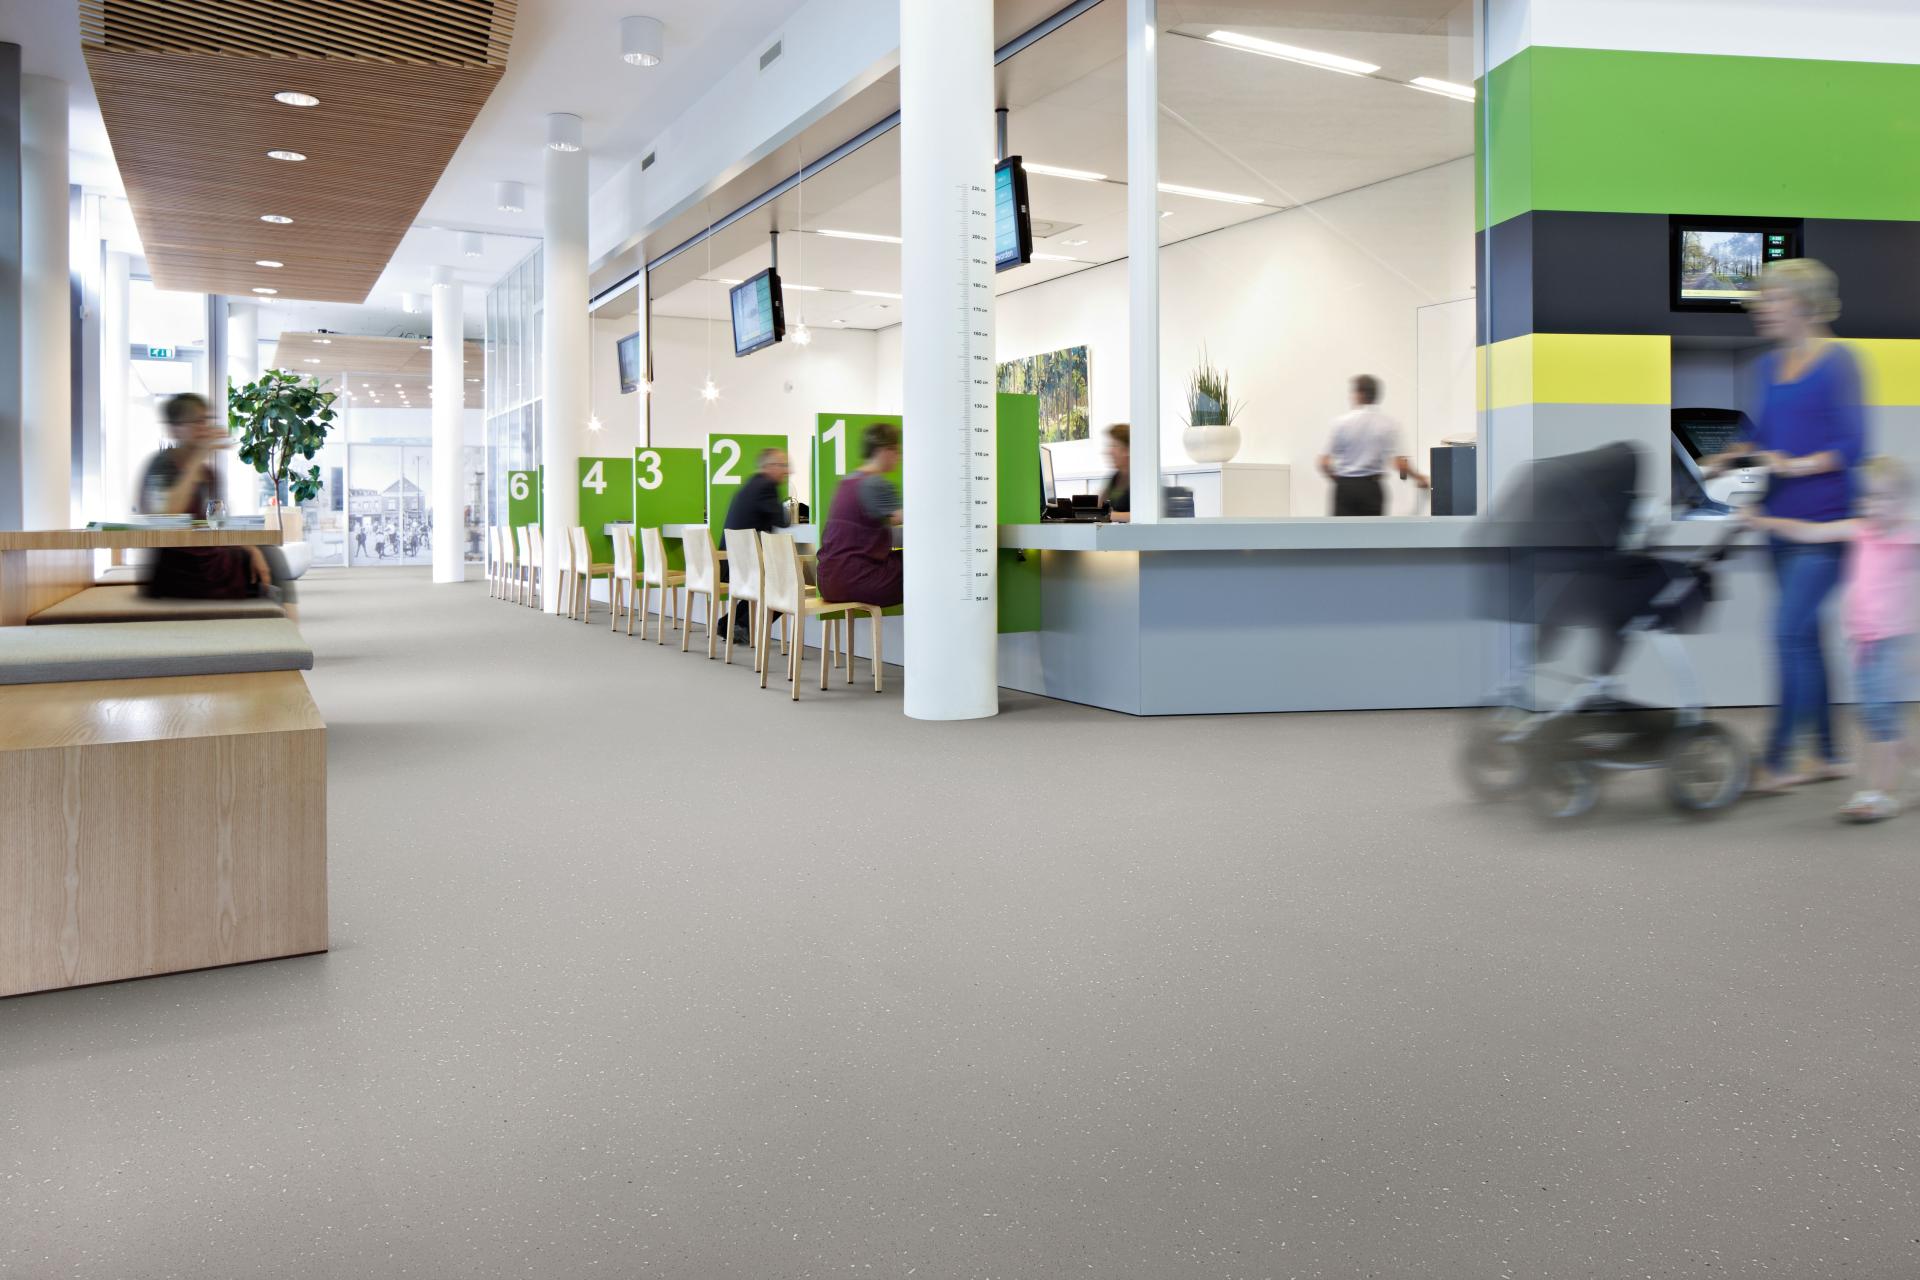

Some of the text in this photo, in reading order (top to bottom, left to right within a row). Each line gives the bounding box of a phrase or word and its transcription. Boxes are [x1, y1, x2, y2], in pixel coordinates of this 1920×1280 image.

[711, 438, 742, 484] 2
[822, 419, 846, 476] 1
[510, 472, 529, 500] 6
[582, 460, 608, 494] 4
[638, 450, 662, 490] 3
